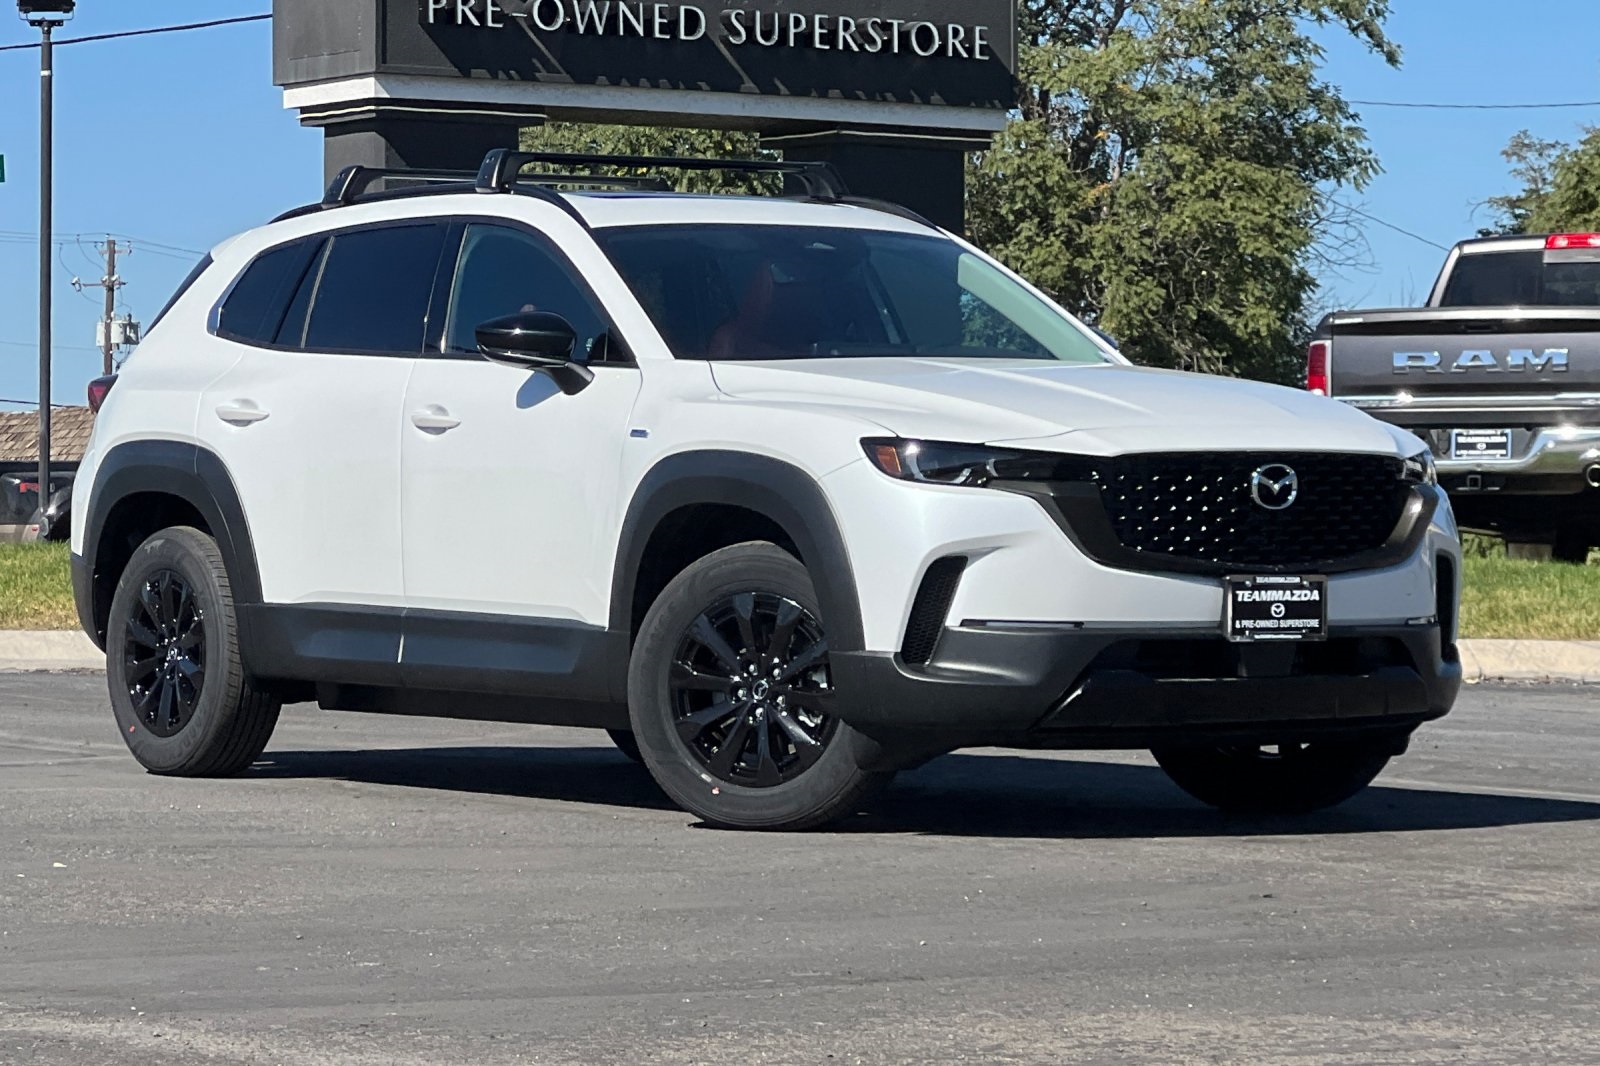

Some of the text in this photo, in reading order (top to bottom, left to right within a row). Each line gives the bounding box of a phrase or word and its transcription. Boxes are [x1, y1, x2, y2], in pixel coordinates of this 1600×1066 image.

[427, 0, 990, 60] PRE-OWNED SUPERSTORE
[1392, 348, 1570, 375] RAM
[1235, 590, 1320, 602] TEAMMAZDA
[1235, 619, 1320, 628] & PRE-OWNED SUPERSTORE
